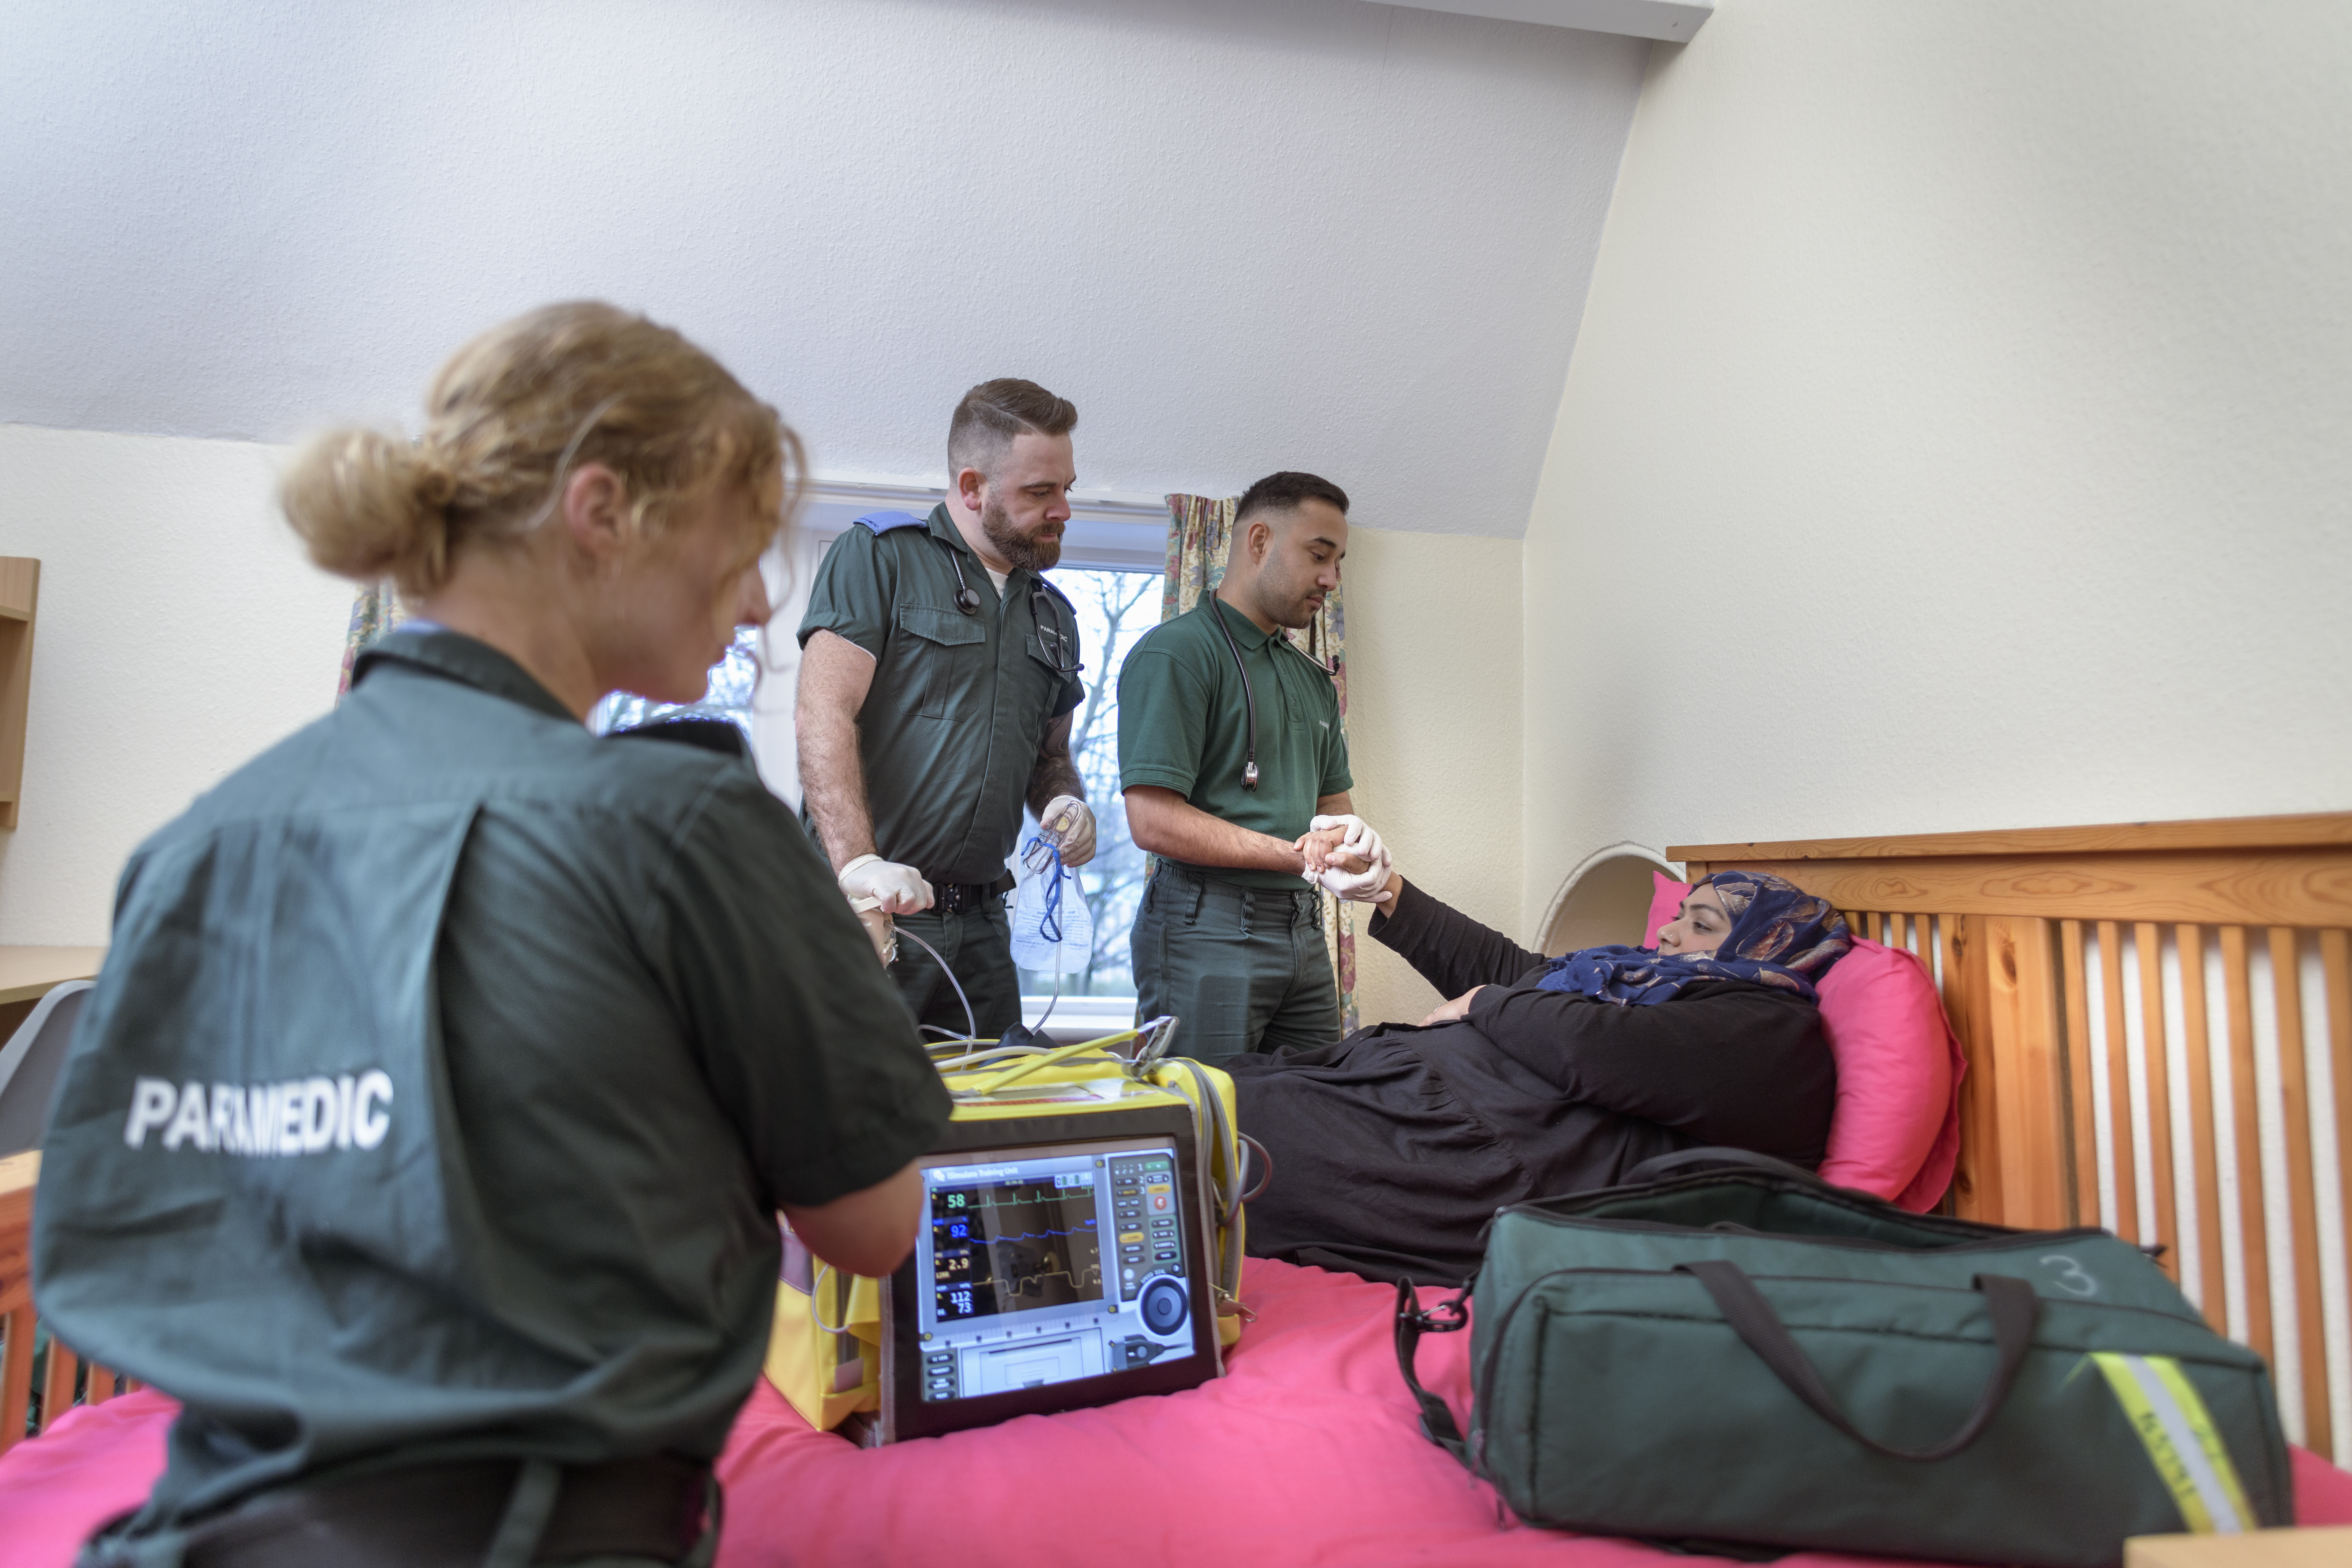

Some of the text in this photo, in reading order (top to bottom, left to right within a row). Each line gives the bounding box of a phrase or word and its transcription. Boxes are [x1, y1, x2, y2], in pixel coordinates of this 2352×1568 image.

[1040, 625, 1067, 642] PARAMDIC
[125, 1068, 394, 1158] PARAMEDIC
[1138, 1163, 1143, 1171] 1
[1139, 1176, 1144, 1184] 2
[1140, 1186, 1145, 1194] 3
[947, 1194, 965, 1208] 58
[950, 1224, 968, 1238] 92
[948, 1257, 970, 1271] 2.9
[1140, 1272, 1154, 1284] SPEED
[2039, 1255, 2098, 1297] 3
[950, 1290, 973, 1304] 112
[958, 1301, 974, 1314] 73
